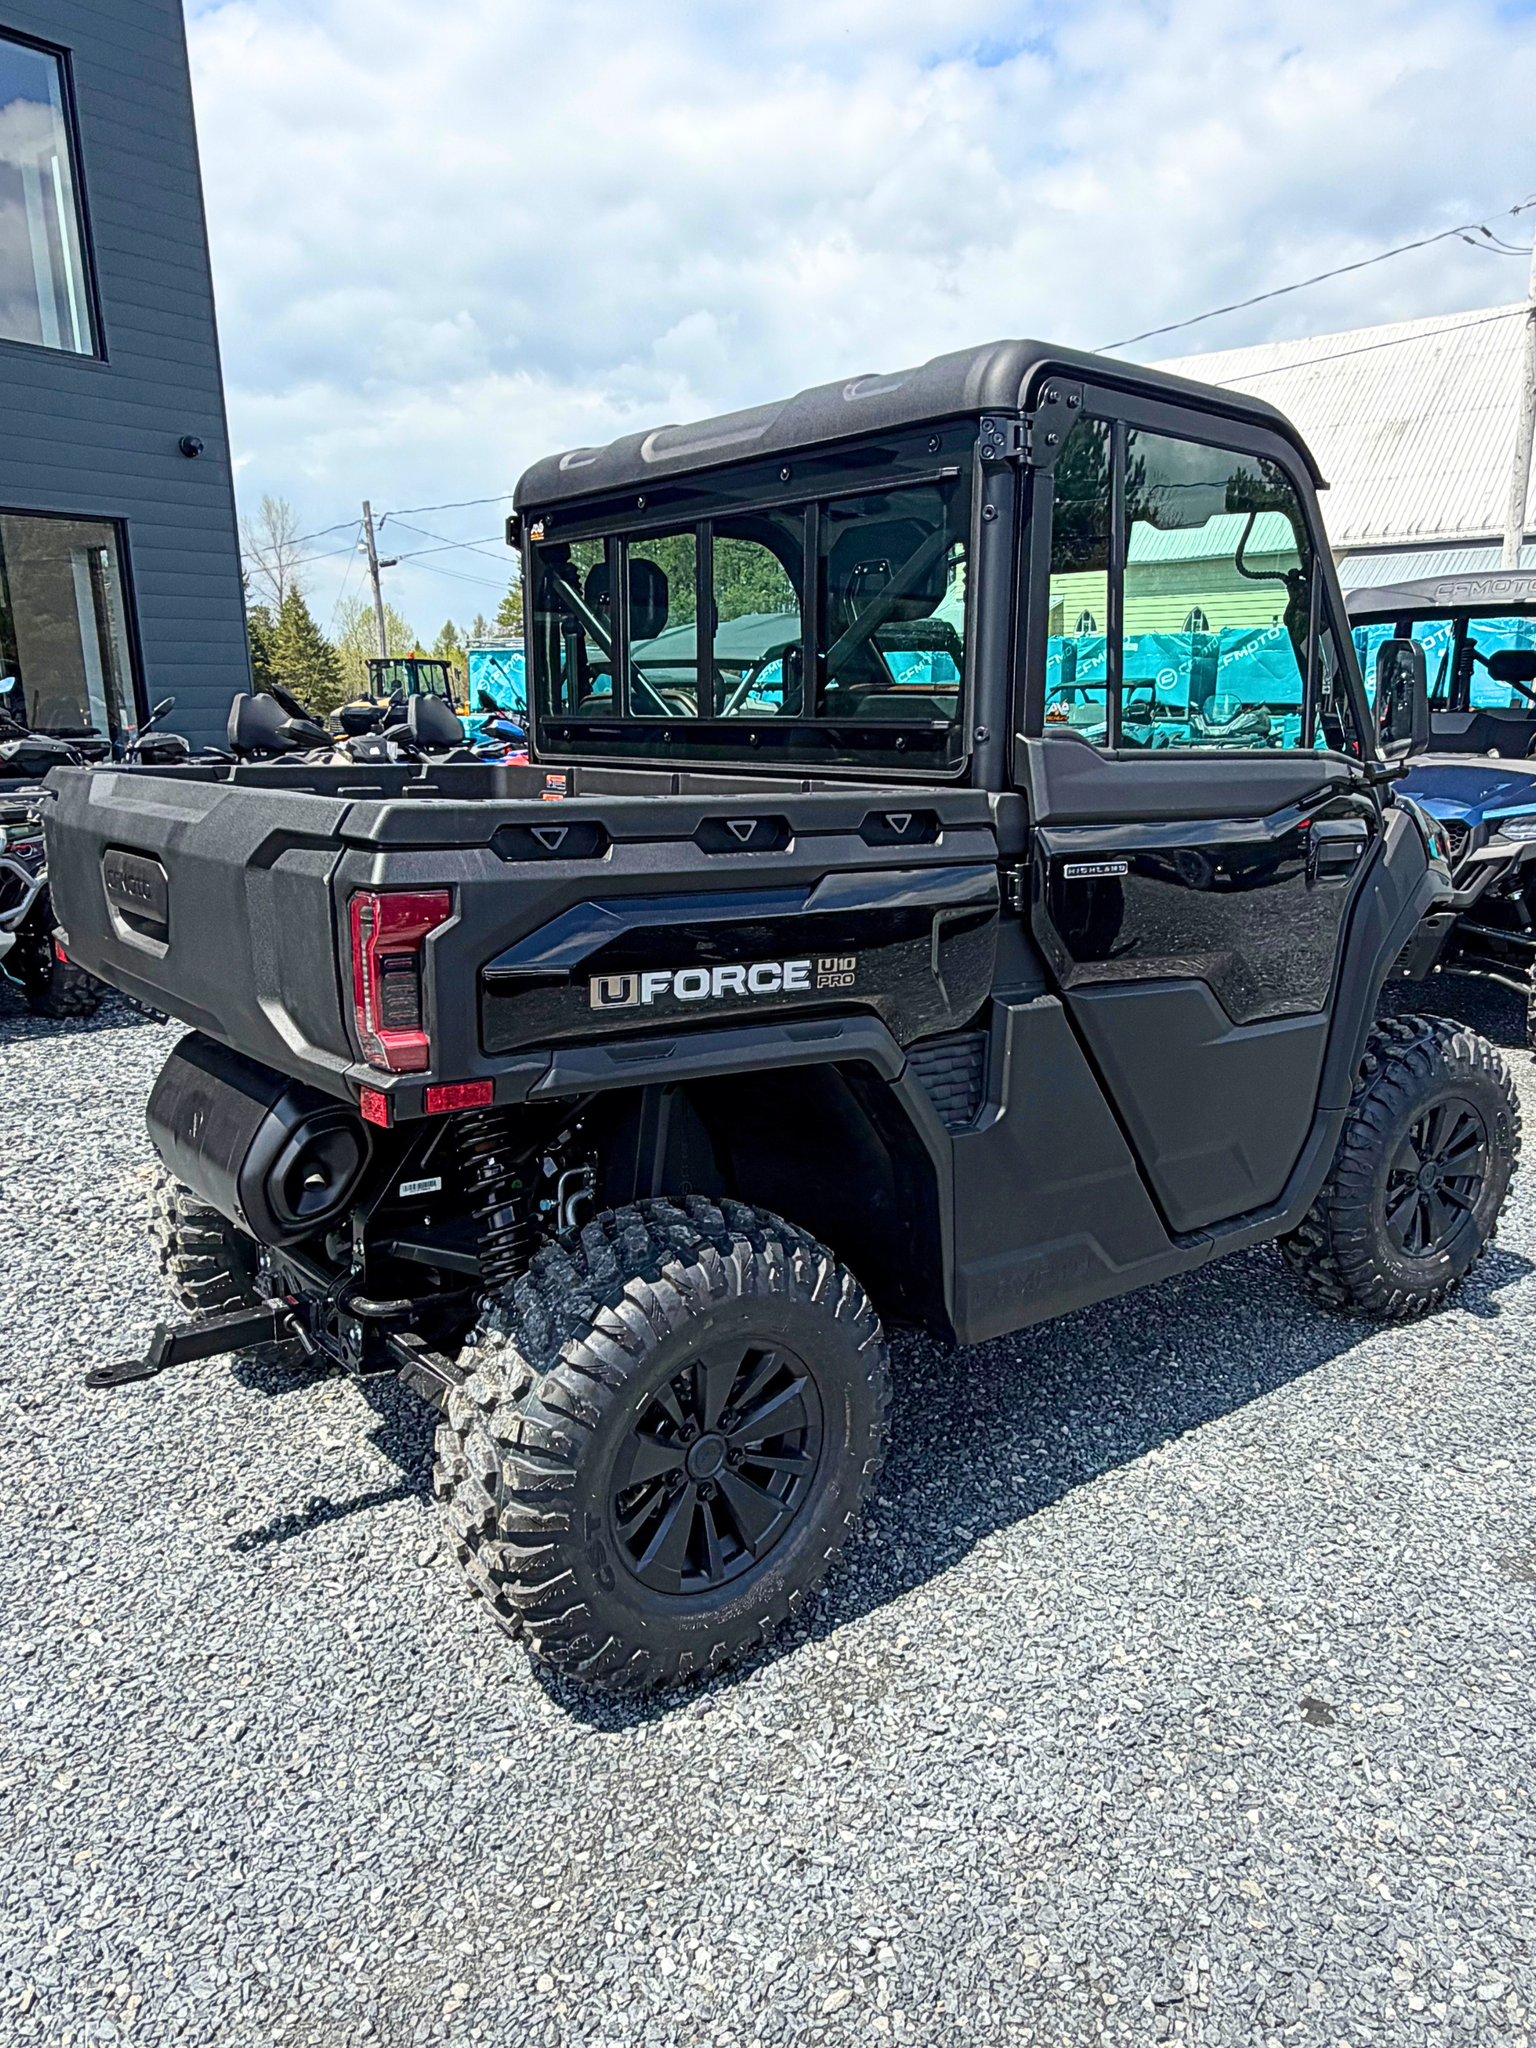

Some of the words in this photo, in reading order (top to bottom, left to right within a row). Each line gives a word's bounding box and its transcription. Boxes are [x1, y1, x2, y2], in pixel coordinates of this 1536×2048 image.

[1068, 865, 1126, 875] HIGHLAND
[818, 957, 856, 974] U10
[817, 972, 855, 989] PRO
